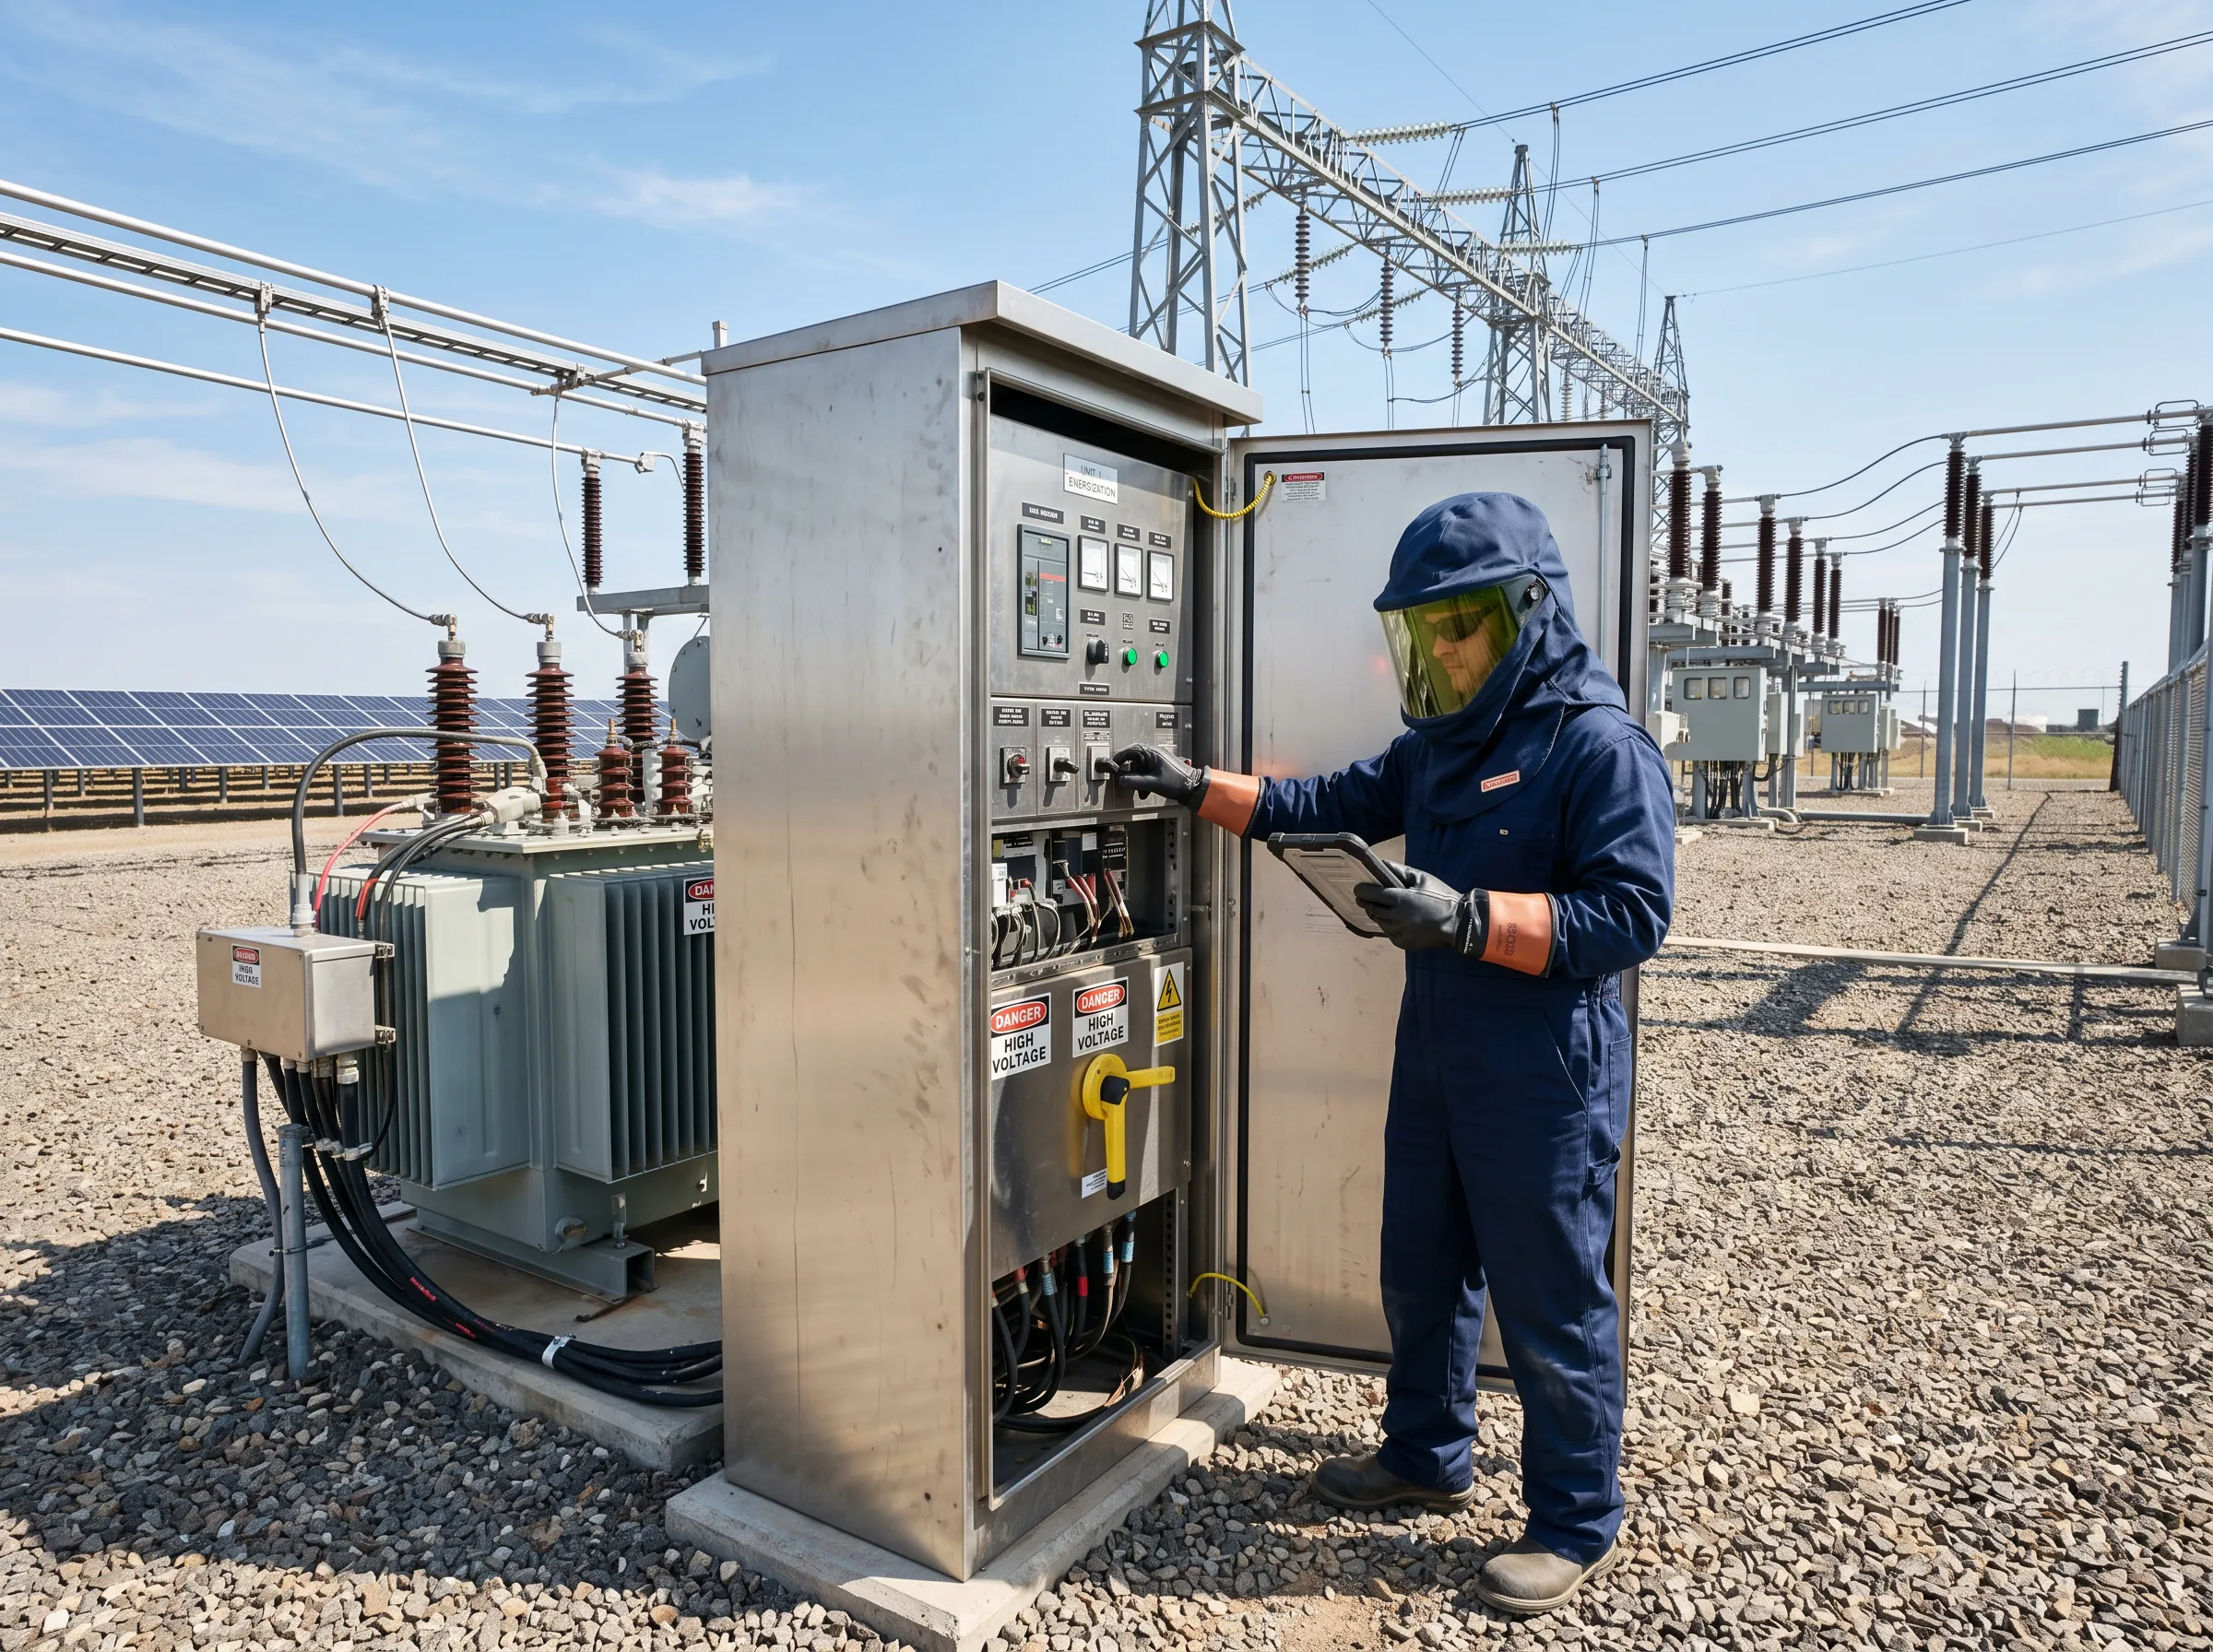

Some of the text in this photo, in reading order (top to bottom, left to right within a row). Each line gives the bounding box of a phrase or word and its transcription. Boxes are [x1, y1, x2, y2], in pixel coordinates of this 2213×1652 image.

[1081, 465, 1095, 478] UNIT
[694, 885, 715, 896] DAN
[703, 903, 715, 914] HI
[995, 1006, 1042, 1030] DANGER
[1088, 1012, 1114, 1032] HIGH
[1004, 1032, 1034, 1054] HIGH
[1077, 1025, 1124, 1051] VOLTAGE
[992, 1045, 1047, 1074] VOLTAGE
